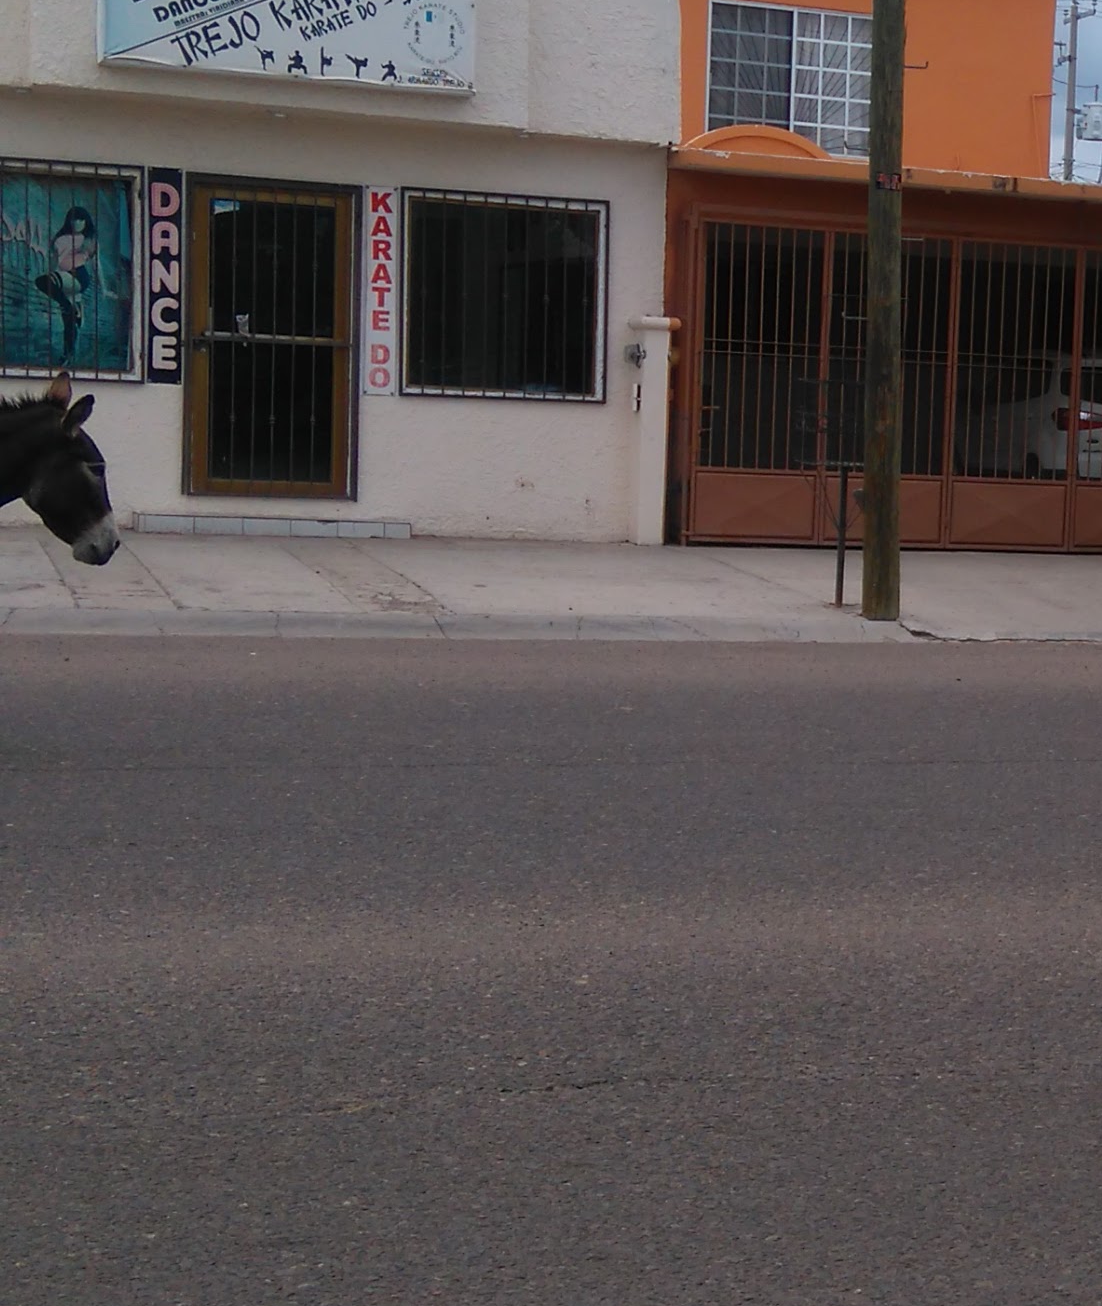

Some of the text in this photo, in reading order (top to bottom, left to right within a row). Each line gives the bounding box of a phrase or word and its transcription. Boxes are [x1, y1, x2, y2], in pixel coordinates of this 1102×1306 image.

[170, 11, 261, 67] TREJO
[299, 9, 354, 42] KARATE
[356, 0, 377, 21] DO
[151, 182, 180, 371] DANCE
[369, 192, 393, 389] KARATE DO
